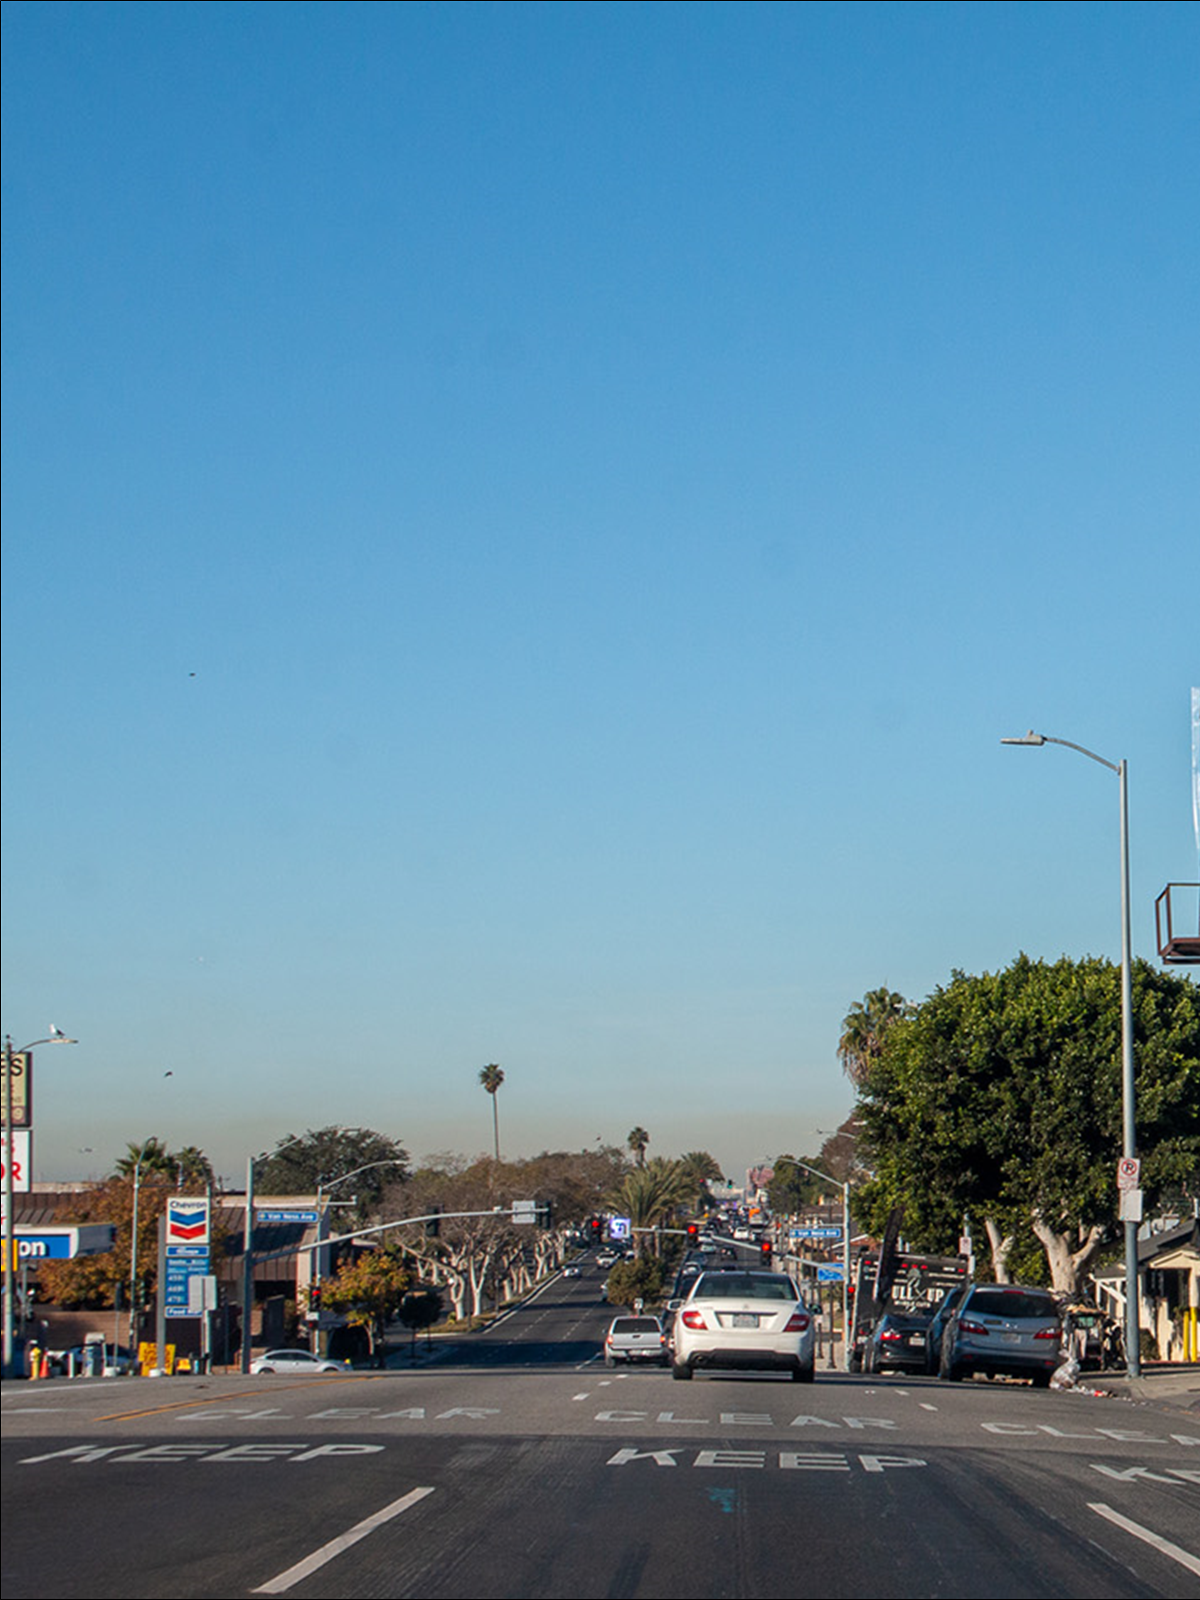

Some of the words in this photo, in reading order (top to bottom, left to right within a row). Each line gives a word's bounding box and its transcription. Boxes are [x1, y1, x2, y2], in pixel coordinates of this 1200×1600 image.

[170, 1201, 207, 1209] Chevron
[175, 1408, 501, 1421] CLEAR
[594, 1411, 901, 1430] CLEAR
[16, 1444, 386, 1464] KEEP
[606, 1448, 928, 1472] KEEP
